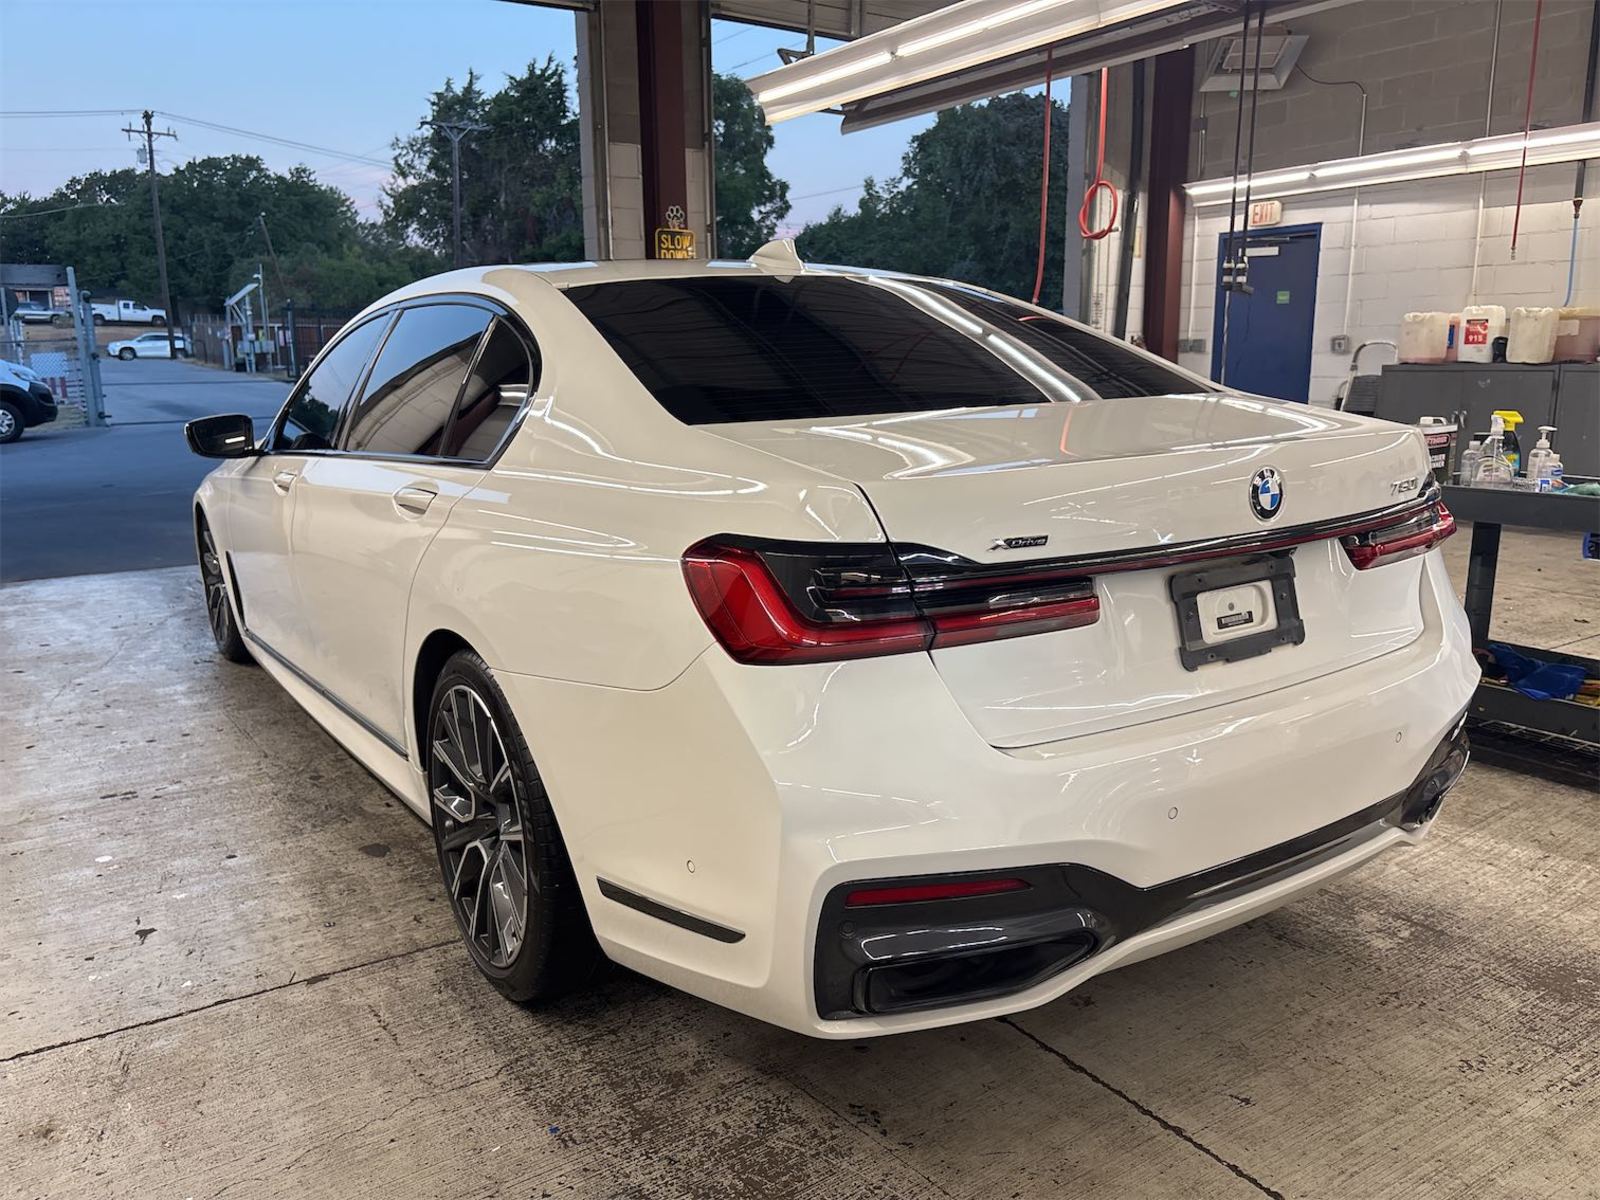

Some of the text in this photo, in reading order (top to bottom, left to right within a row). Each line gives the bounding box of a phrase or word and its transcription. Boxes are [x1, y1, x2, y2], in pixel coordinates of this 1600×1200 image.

[1252, 202, 1275, 225] EXIT
[660, 234, 691, 249] SLOW
[1253, 468, 1281, 487] BMW
